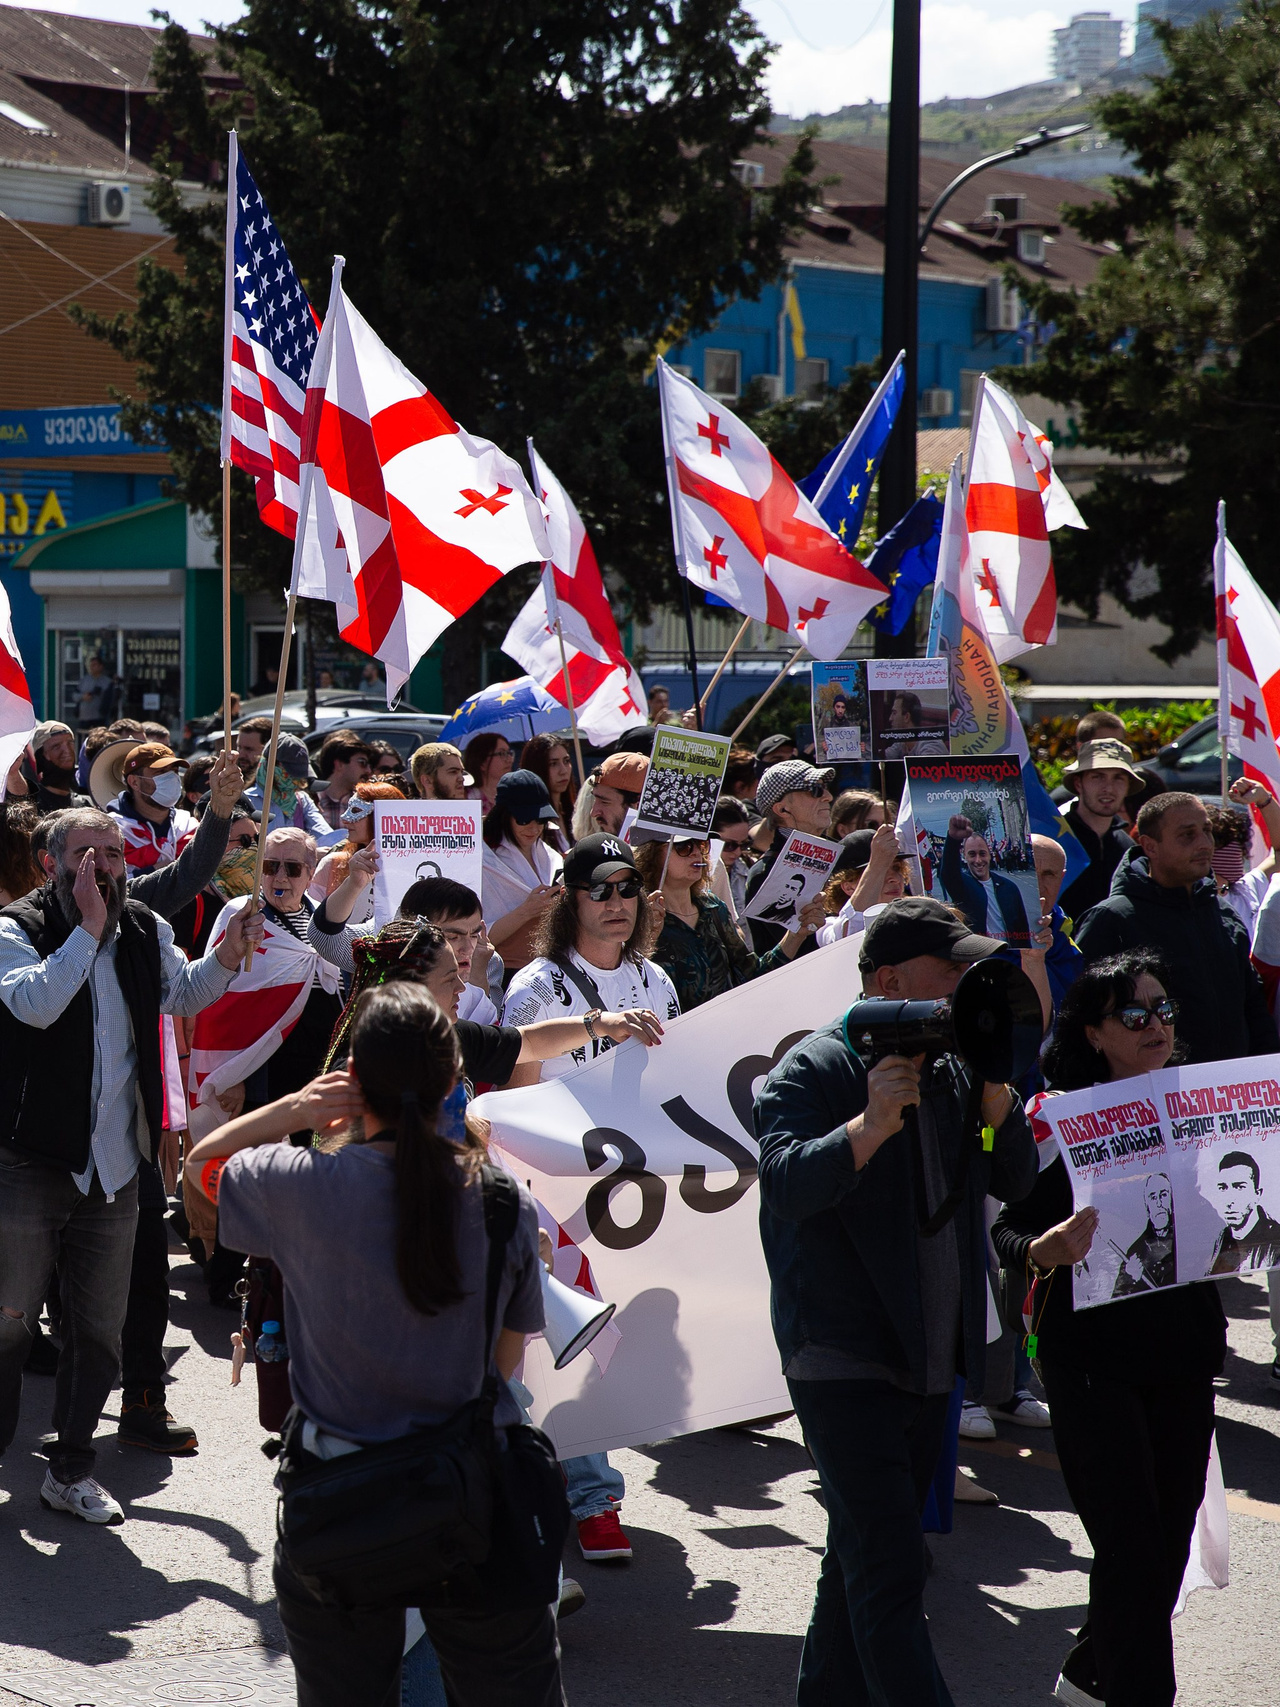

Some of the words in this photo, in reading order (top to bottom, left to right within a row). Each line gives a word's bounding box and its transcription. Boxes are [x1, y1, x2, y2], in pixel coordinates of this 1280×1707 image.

[910, 761, 1020, 784] თავისუფლება
[927, 789, 963, 803] გიორგი
[381, 815, 475, 835] თავისუფლება
[381, 835, 406, 849] მზია
[601, 839, 622, 856] NY
[1164, 1078, 1280, 1119] თავისუფლებ
[1057, 1097, 1160, 1146] თავისუფლება
[1171, 1116, 1215, 1140] არჩილ
[1218, 1107, 1280, 1133] მუსელიან
[1068, 1138, 1111, 1168] თემურ
